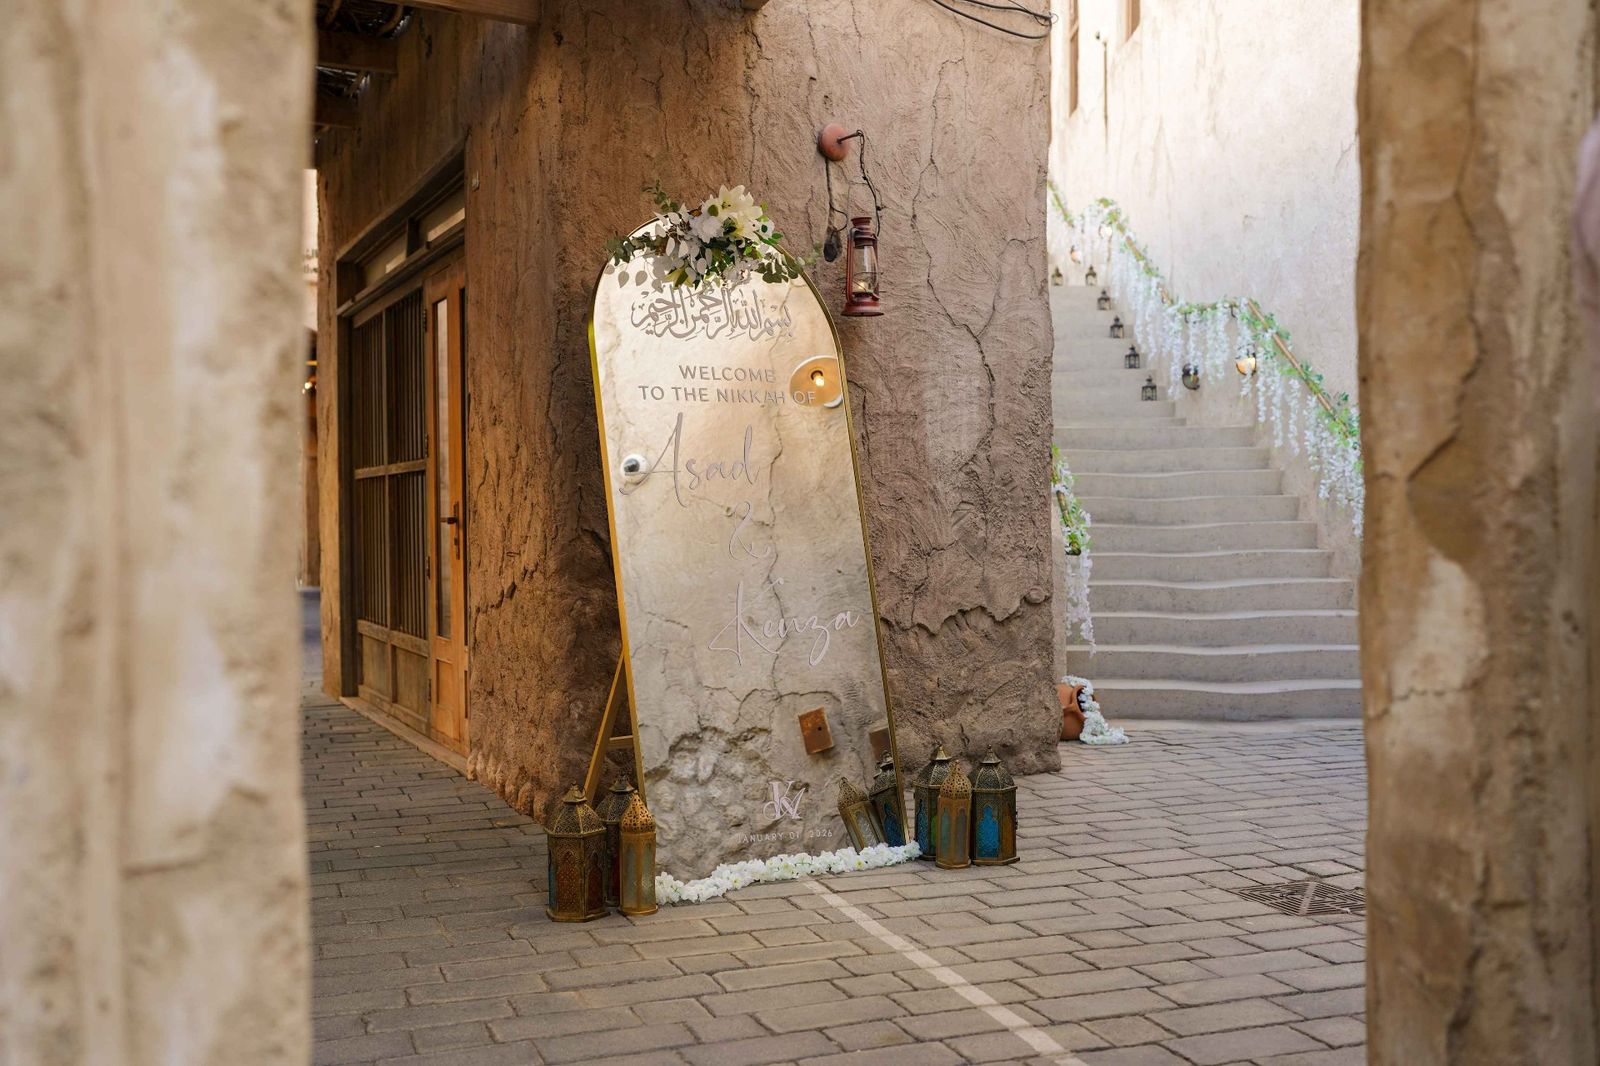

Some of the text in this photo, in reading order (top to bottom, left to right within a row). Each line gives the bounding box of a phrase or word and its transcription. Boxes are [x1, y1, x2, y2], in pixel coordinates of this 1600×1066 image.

[638, 385, 817, 405] TO THE NIKKAH OF
[678, 364, 777, 384] WELCOME
[618, 411, 761, 509] Asad
[728, 500, 772, 561] &
[707, 577, 861, 668] Kenza
